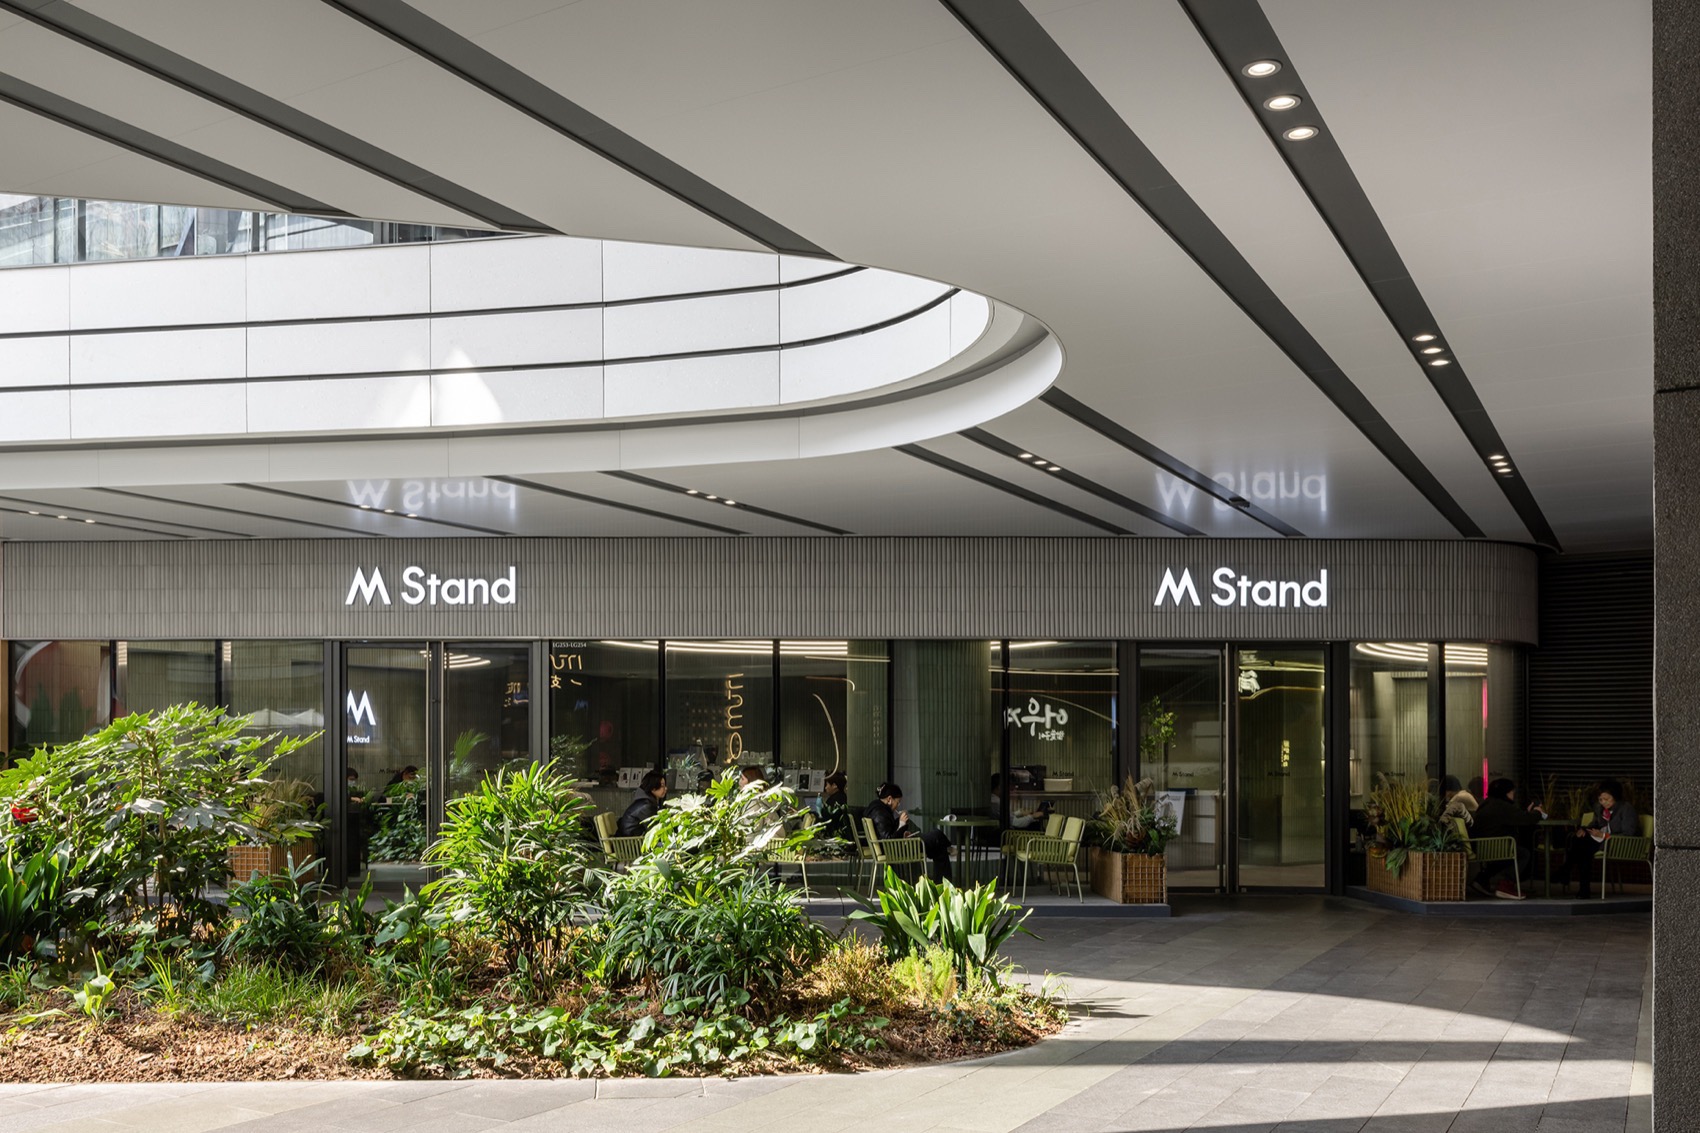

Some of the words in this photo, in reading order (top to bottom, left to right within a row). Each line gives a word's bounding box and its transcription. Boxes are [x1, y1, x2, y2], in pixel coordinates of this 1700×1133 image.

[345, 566, 391, 605] M
[401, 566, 516, 605] Stand
[1154, 567, 1201, 606] M
[1211, 567, 1328, 607] Stand
[347, 689, 376, 726] M
[353, 735, 370, 744] Stand
